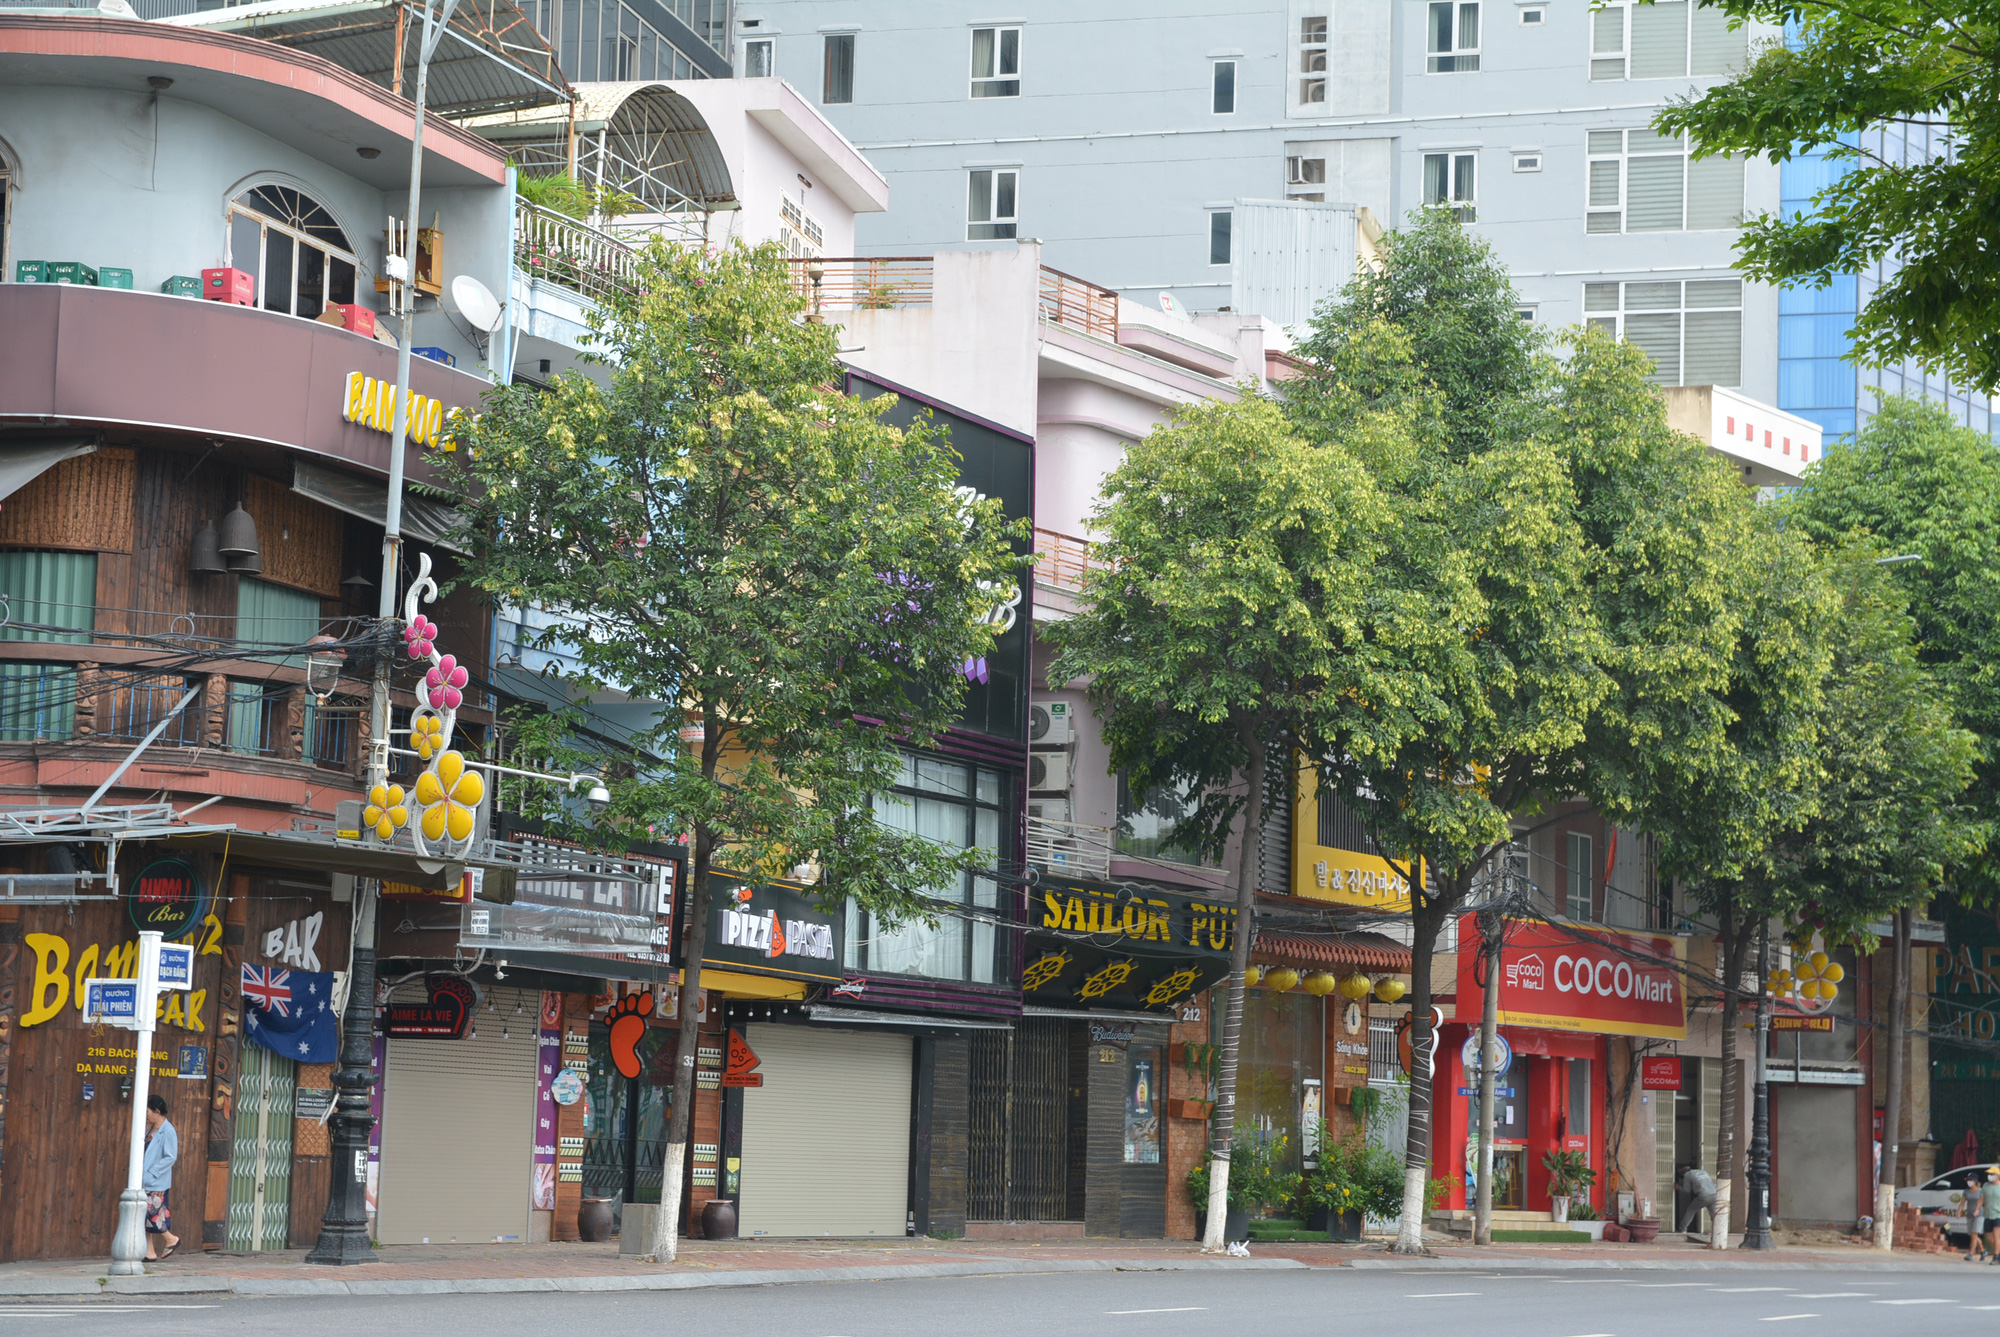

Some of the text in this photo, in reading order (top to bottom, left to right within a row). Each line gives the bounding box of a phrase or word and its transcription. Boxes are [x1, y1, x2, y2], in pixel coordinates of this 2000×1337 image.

[1331, 869, 1343, 890] &
[138, 878, 182, 903] BAMBOO
[148, 904, 186, 922] Bar
[1043, 888, 1171, 942] SAILOR
[202, 914, 222, 956] 2
[263, 911, 323, 973] BAR
[786, 920, 834, 960] PASTA
[1519, 964, 1541, 976] COCO
[1523, 978, 1537, 989] Mart
[1554, 955, 1673, 1003] COCO Mart
[105, 988, 130, 997] ĐƯỜNG
[156, 988, 206, 1031] AR
[392, 1010, 452, 1021] AIME LA VIE
[1183, 1008, 1200, 1021] 212
[1091, 1027, 1135, 1041] Budweiser
[88, 1047, 168, 1060] 216 BACH ANG
[1099, 1049, 1116, 1062] 212
[77, 1063, 91, 1073] DA
[95, 1064, 127, 1074] NANG
[159, 1068, 178, 1077] NAM
